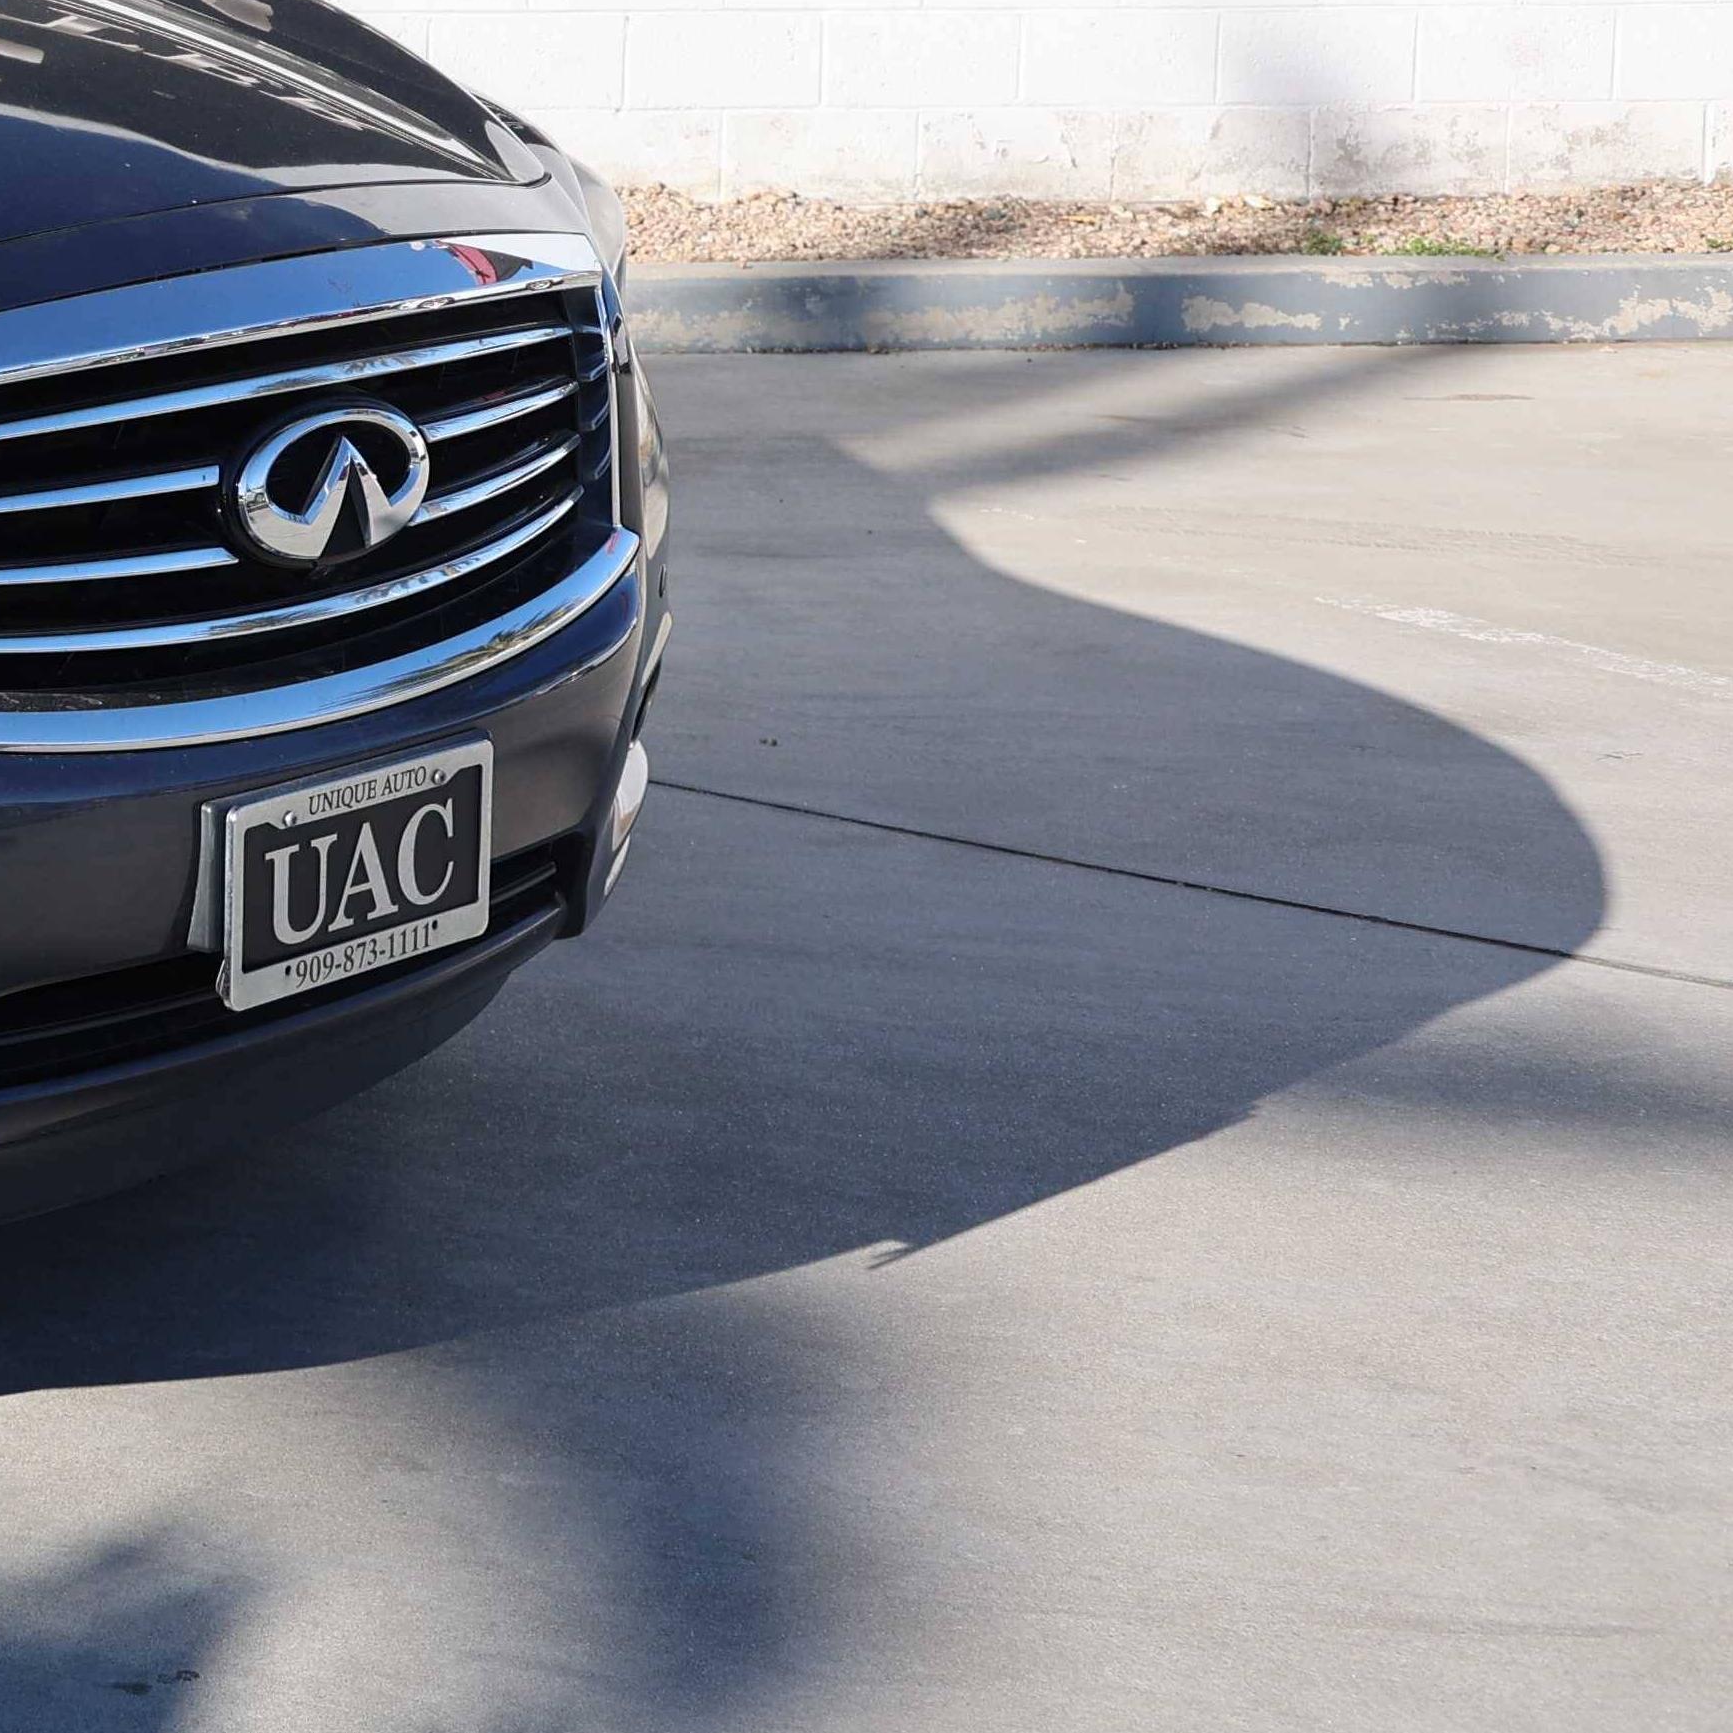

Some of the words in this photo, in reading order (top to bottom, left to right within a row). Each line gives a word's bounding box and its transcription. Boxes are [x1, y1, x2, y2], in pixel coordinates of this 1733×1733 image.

[308, 778, 378, 816] UNIQUE
[381, 766, 428, 798] AUTO
[265, 797, 455, 945] UAC
[294, 921, 432, 989] 909-873-1111
